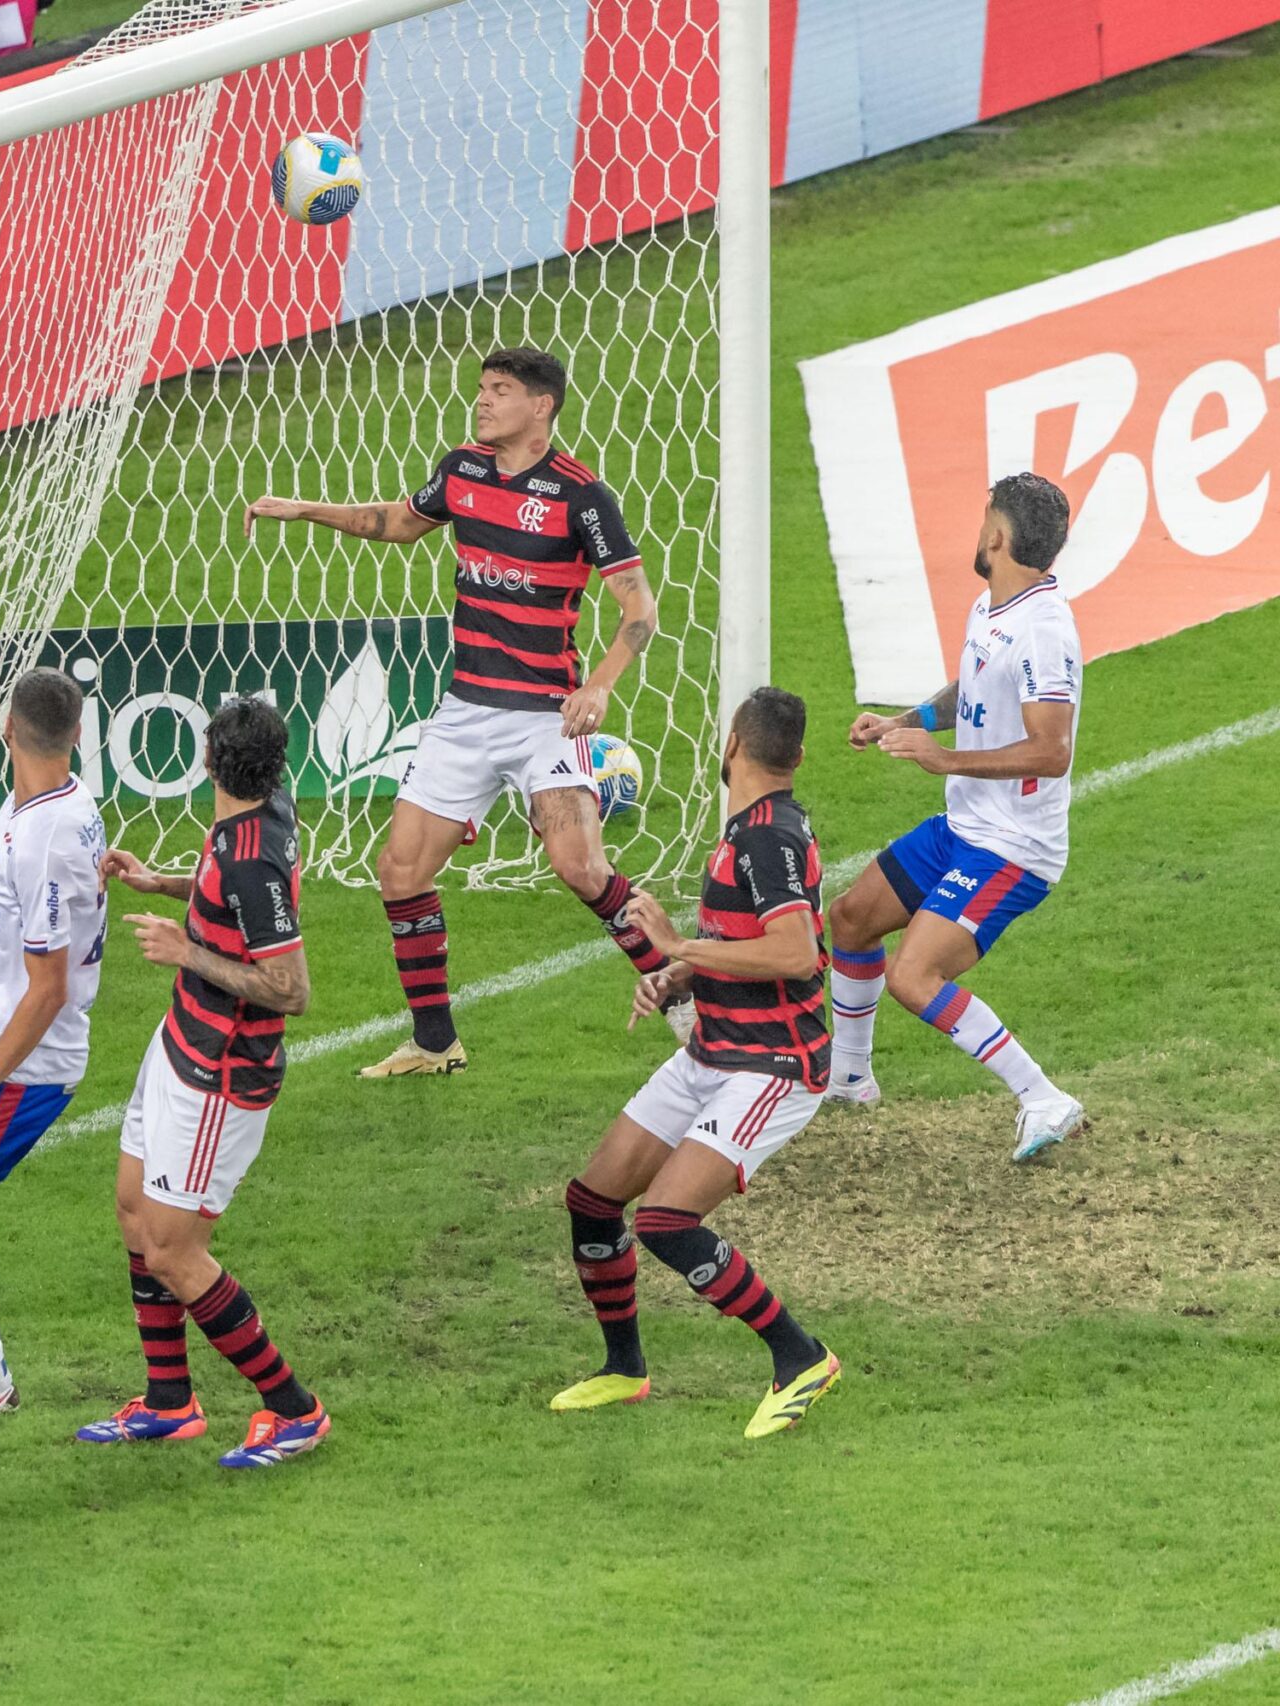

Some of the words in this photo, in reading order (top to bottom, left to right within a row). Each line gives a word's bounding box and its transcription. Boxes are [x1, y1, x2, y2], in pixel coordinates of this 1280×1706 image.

[467, 463, 488, 479] BRB
[539, 480, 561, 495] BRB
[985, 343, 1280, 602] Be
[589, 521, 612, 559] kwai
[780, 847, 800, 882] kwai
[47, 880, 59, 930] novibet
[266, 881, 287, 918] kwai
